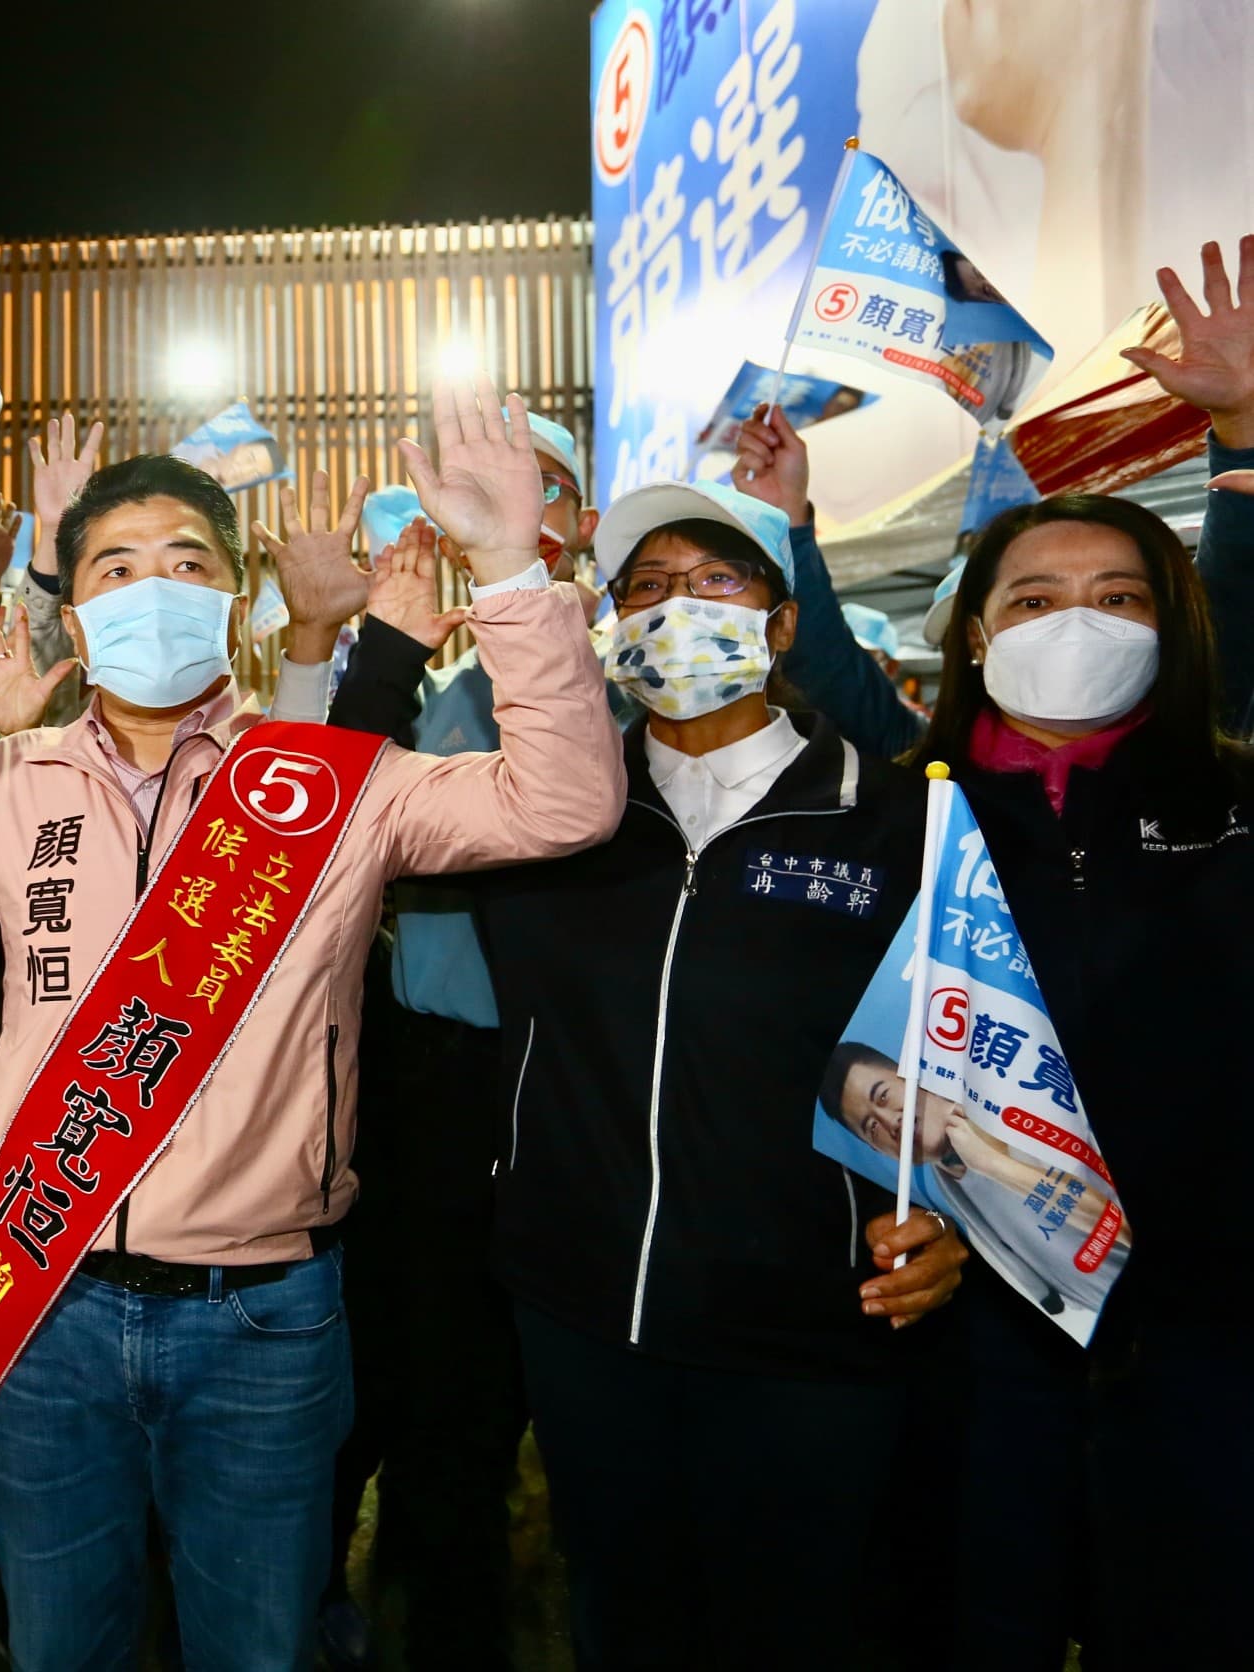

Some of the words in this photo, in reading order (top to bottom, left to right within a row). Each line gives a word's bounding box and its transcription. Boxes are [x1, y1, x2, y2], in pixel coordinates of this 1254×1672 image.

[841, 232, 946, 283] 不必講幹
[128, 817, 249, 987] 候選人
[751, 871, 871, 916] 冉齡軒
[759, 853, 872, 886] 台中市議員
[22, 814, 85, 1006] 顏寬恒
[186, 849, 295, 1015] 立法委員
[1009, 1112, 1112, 1181] 2022/01/0
